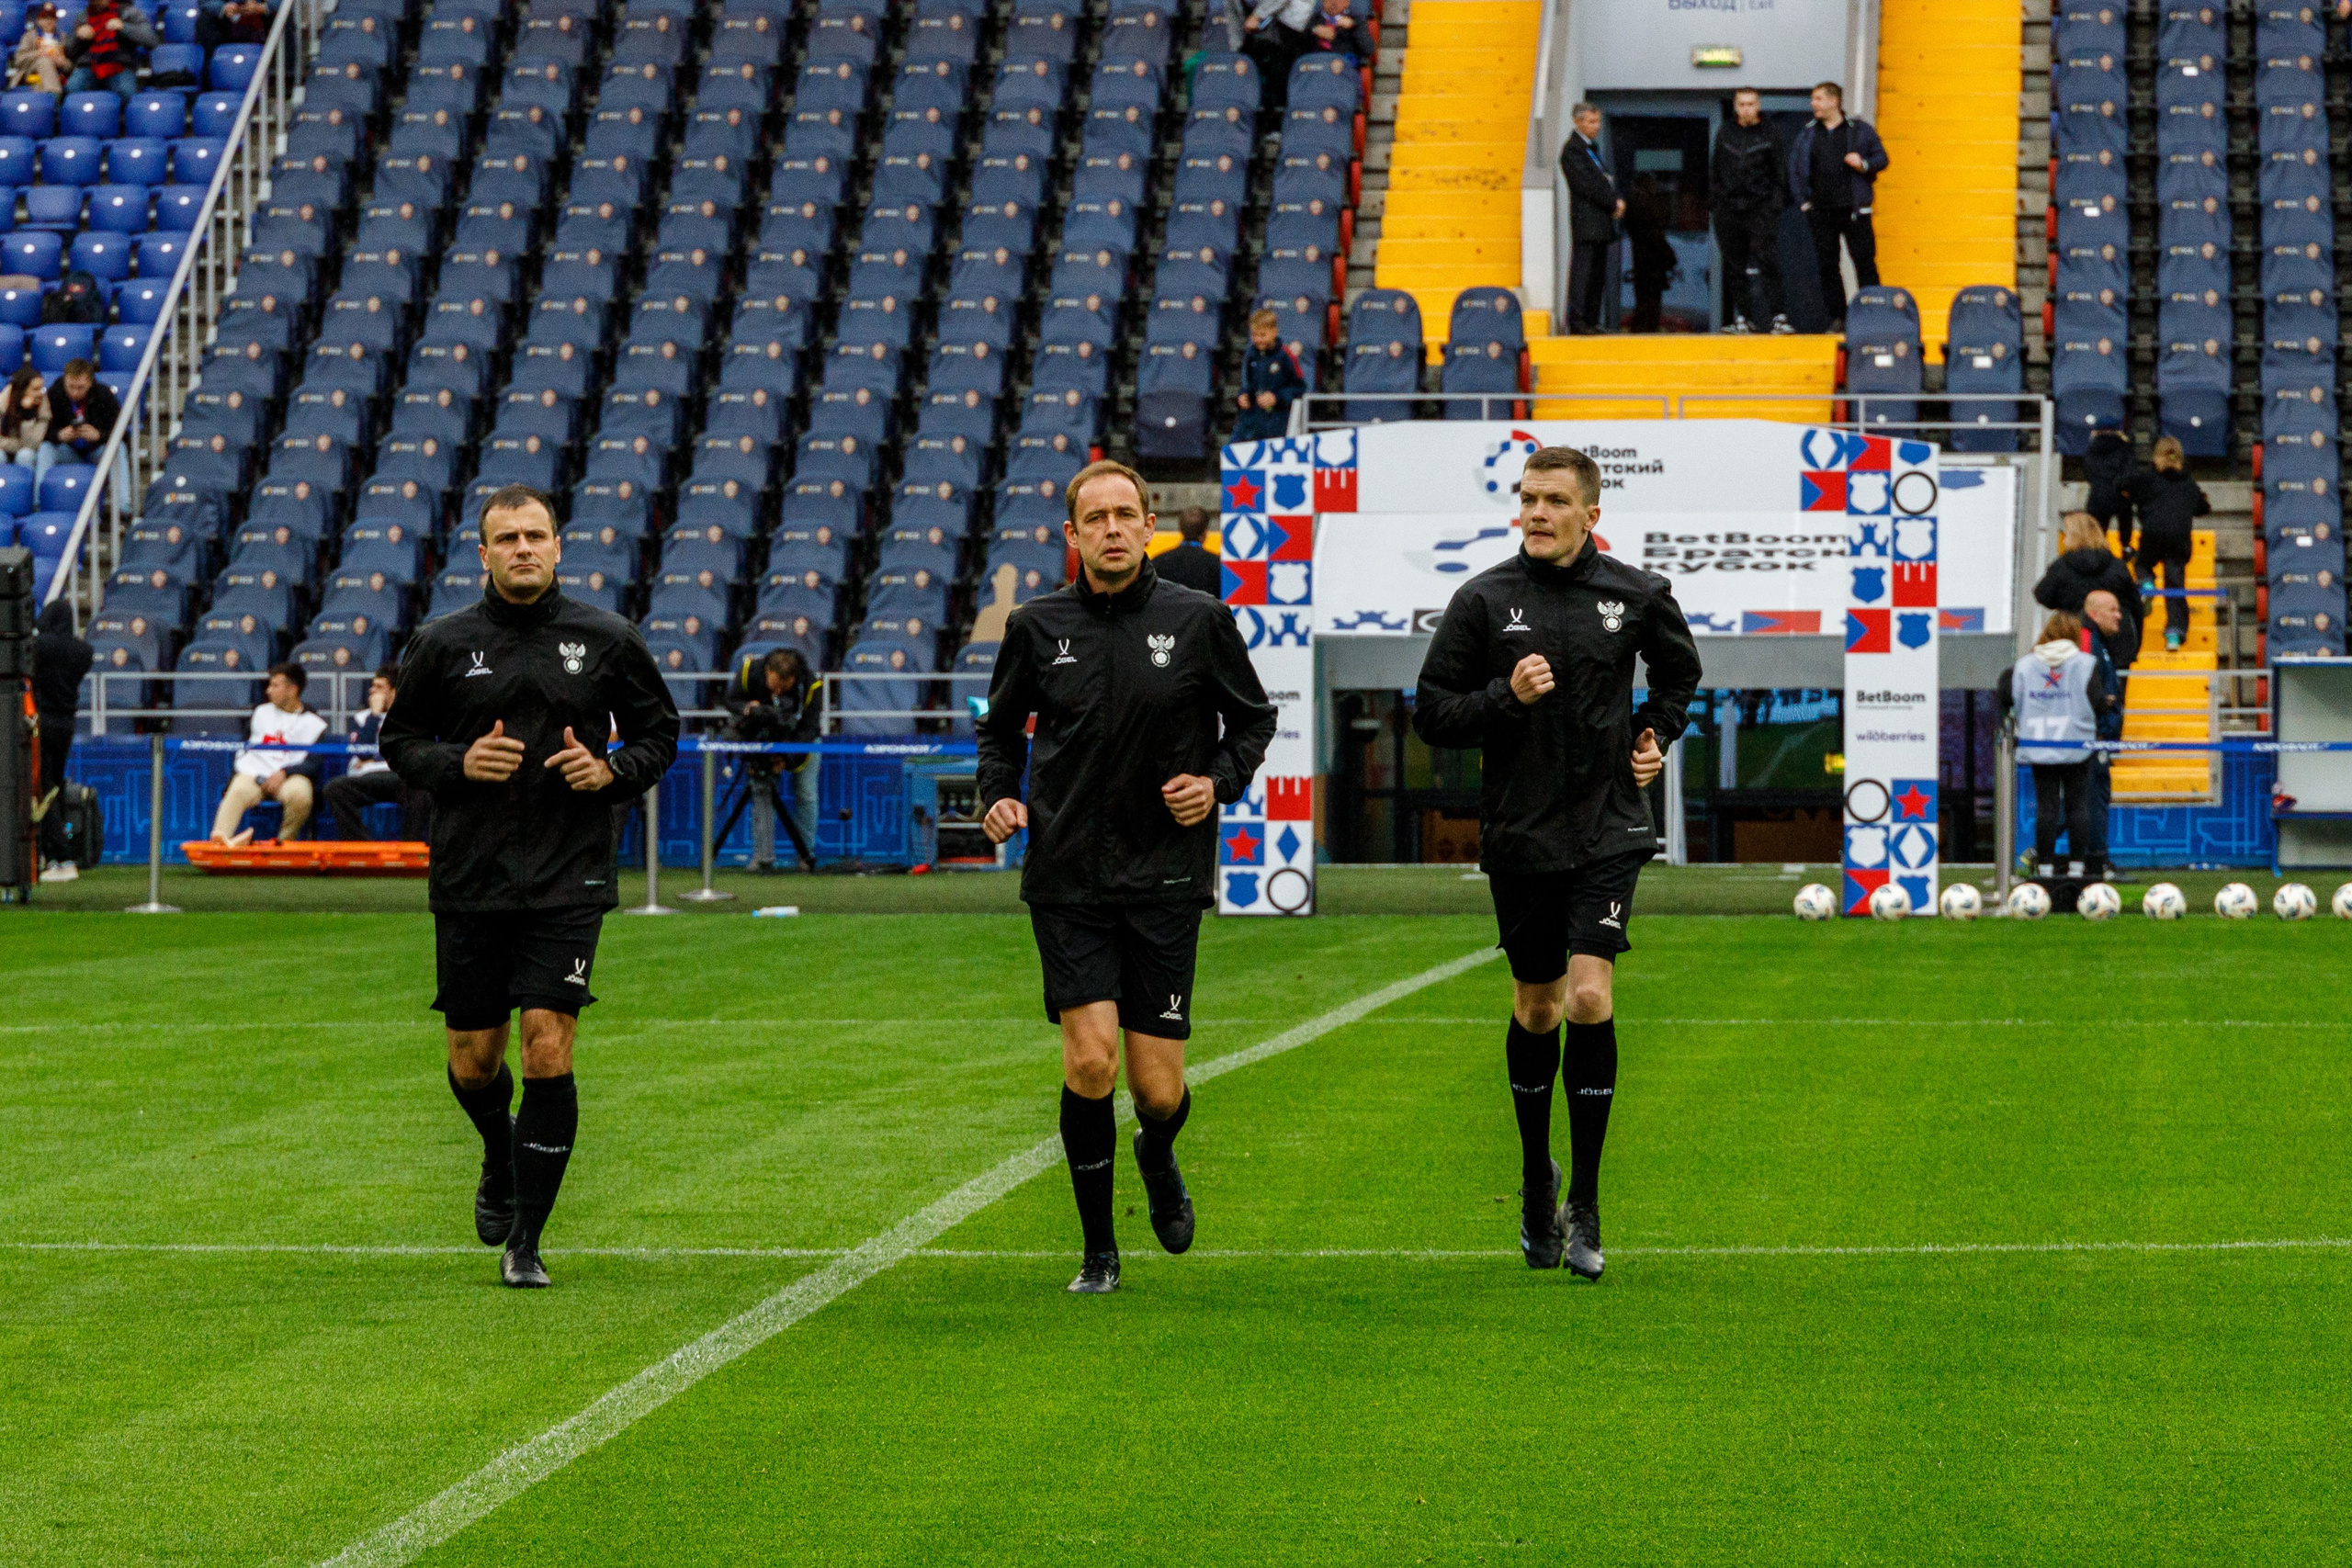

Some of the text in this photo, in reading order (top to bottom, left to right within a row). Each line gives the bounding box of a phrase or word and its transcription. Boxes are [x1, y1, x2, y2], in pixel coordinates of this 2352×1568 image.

[1601, 459, 1664, 474] тский
[1645, 532, 1846, 544] BetBoom
[1644, 547, 1846, 559] Братск
[1856, 690, 1926, 703] BetBoom
[2026, 716, 2071, 740] 17
